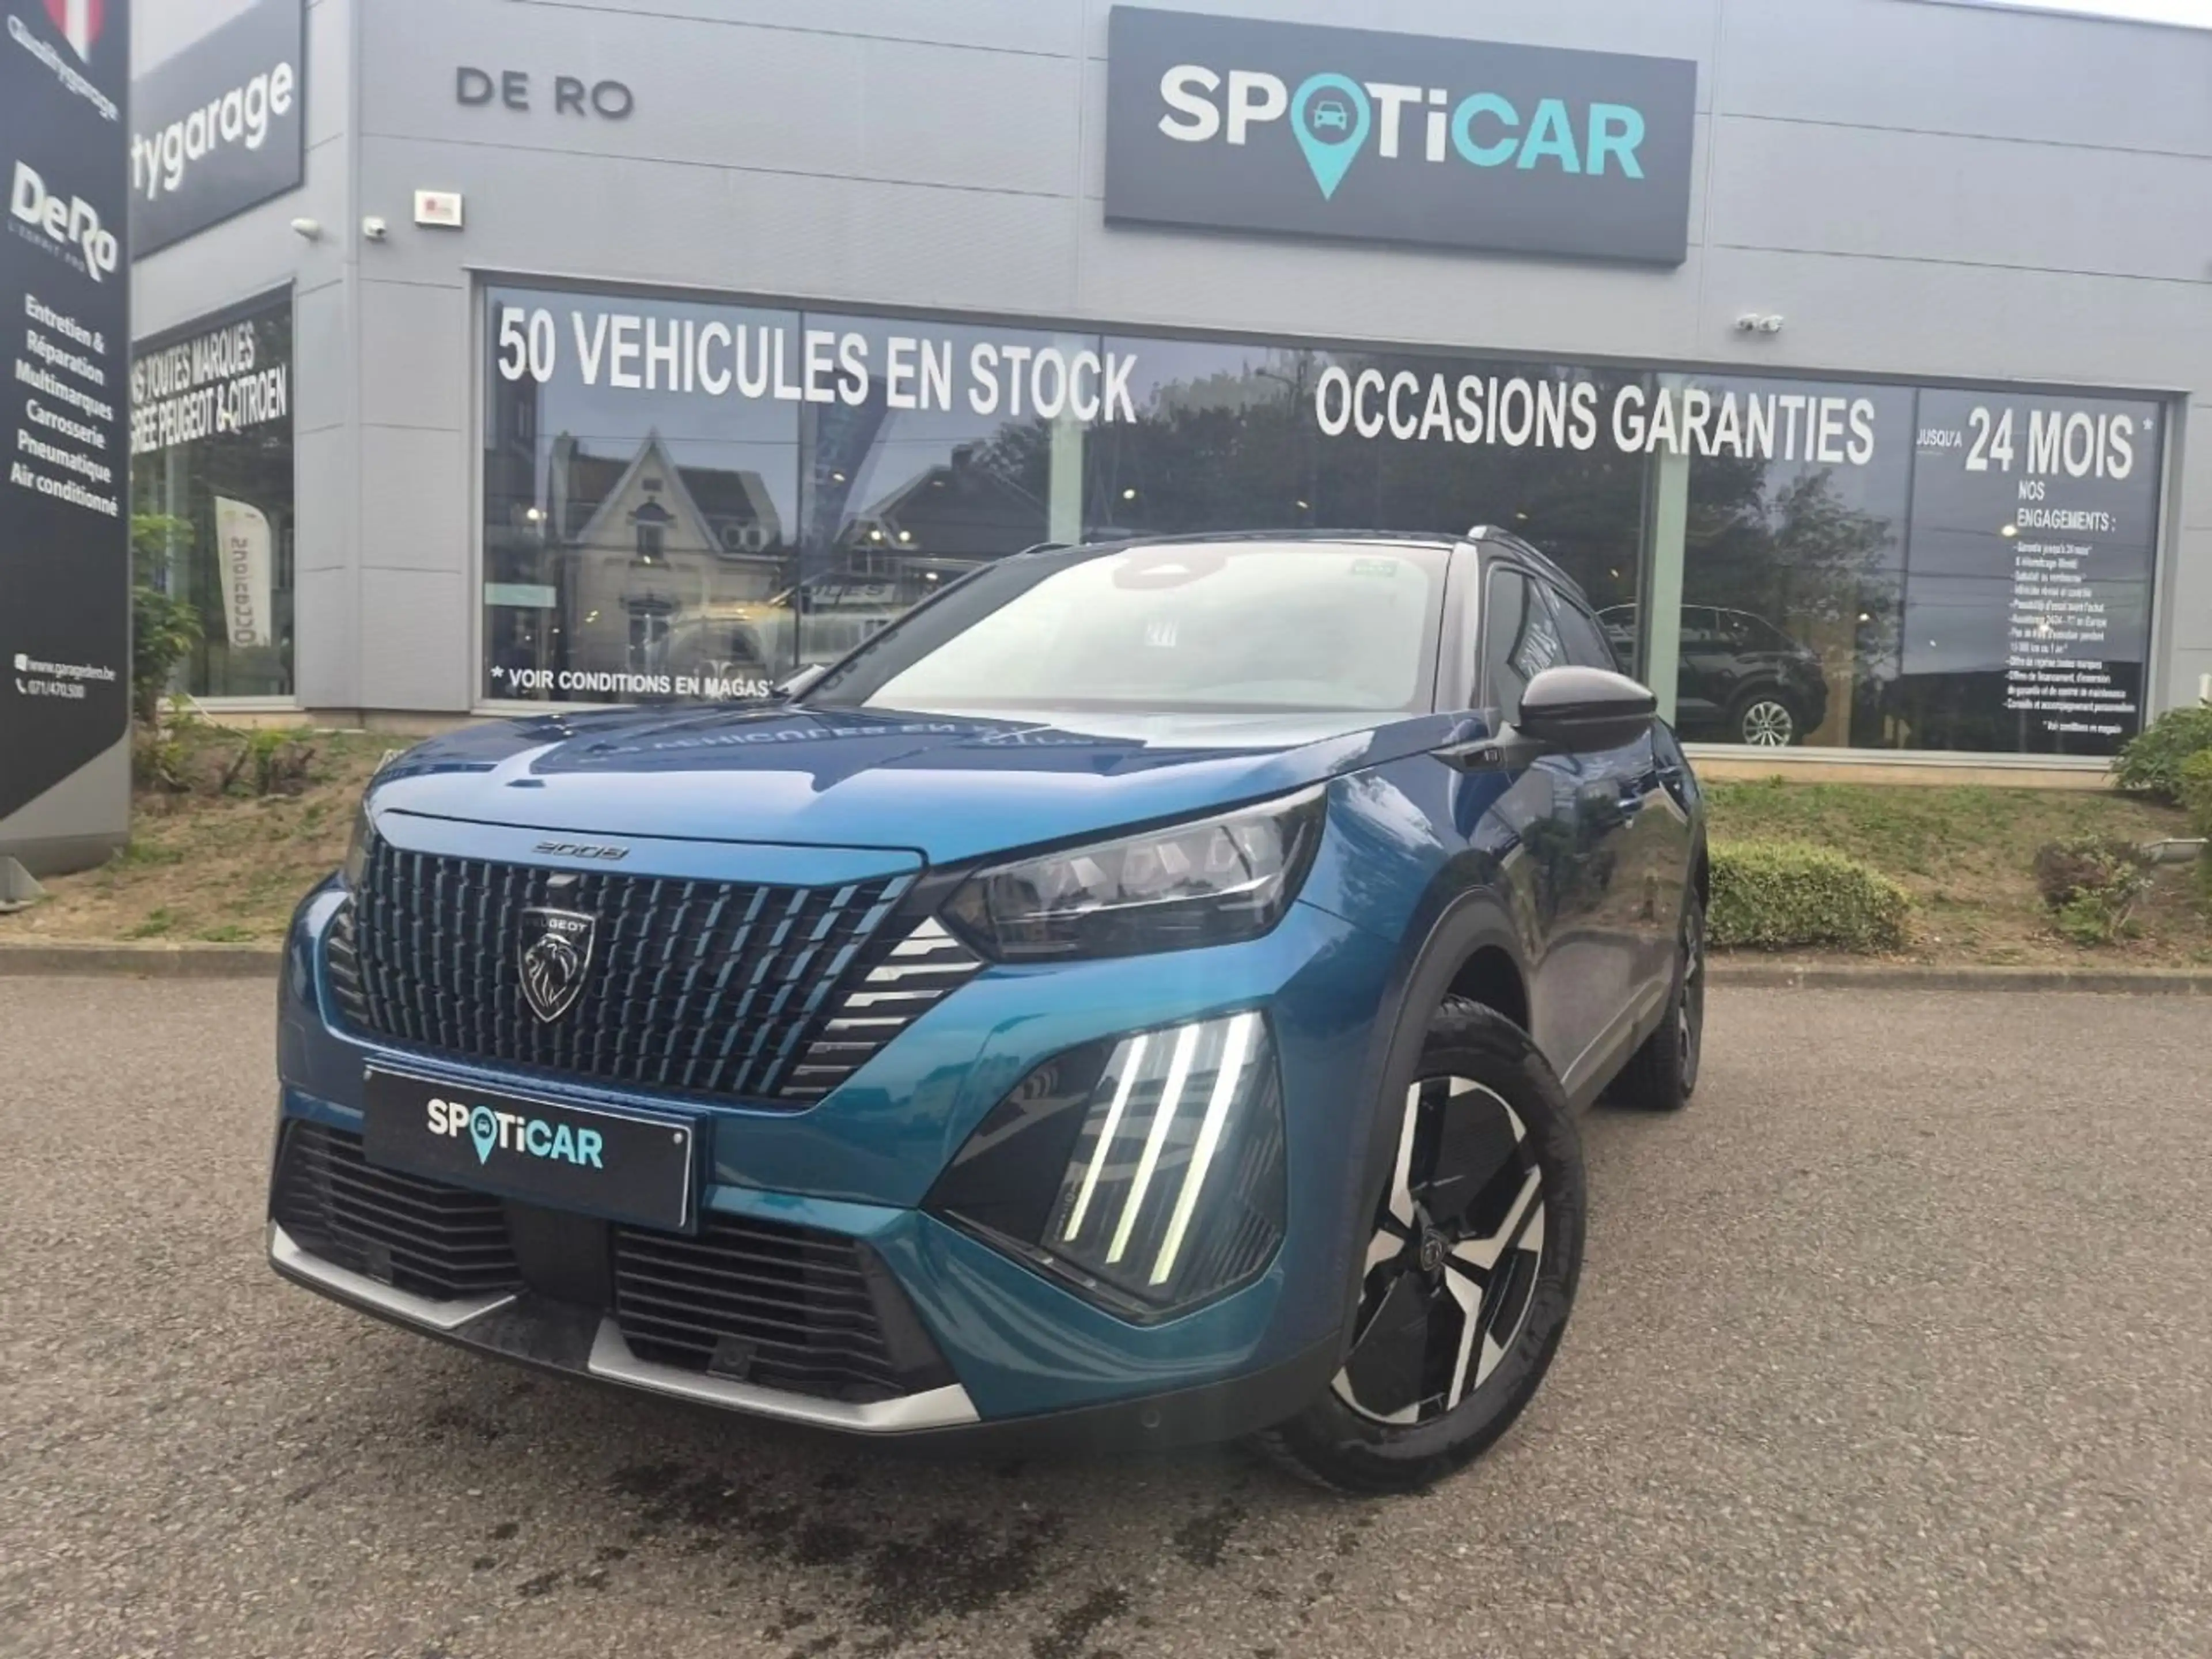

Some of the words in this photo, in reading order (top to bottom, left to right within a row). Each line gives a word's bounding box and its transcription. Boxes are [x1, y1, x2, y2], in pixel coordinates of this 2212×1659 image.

[456, 66, 529, 111] DE
[555, 75, 634, 119] RO
[10, 159, 119, 282] DeRo
[25, 293, 91, 347] Entretien
[93, 331, 105, 354] &
[192, 320, 255, 384] MARQUES
[26, 329, 104, 387] Réparation
[498, 306, 556, 383] 50
[572, 311, 869, 406] VEHICULES
[887, 336, 952, 411] EN
[968, 343, 1138, 423] STOCK
[15, 358, 113, 421] Multimarques
[158, 387, 214, 447] PEUGEOT
[216, 382, 225, 433] &
[228, 362, 286, 429] CITROEN
[1315, 366, 1597, 450] OCCASIONS
[1613, 385, 1875, 465] GARANTIES
[26, 399, 106, 450] Carrosserie
[1916, 427, 1963, 449] JUSQU'A
[1965, 406, 2014, 472] 24
[2027, 410, 2134, 480] MOIS
[17, 428, 112, 484] Pneumatique
[10, 461, 35, 490] Air
[36, 475, 119, 518] conditionné
[2018, 479, 2045, 501] NOS
[509, 668, 554, 690] VOIR
[558, 671, 670, 695] CONDITIONS
[675, 676, 701, 695] EN
